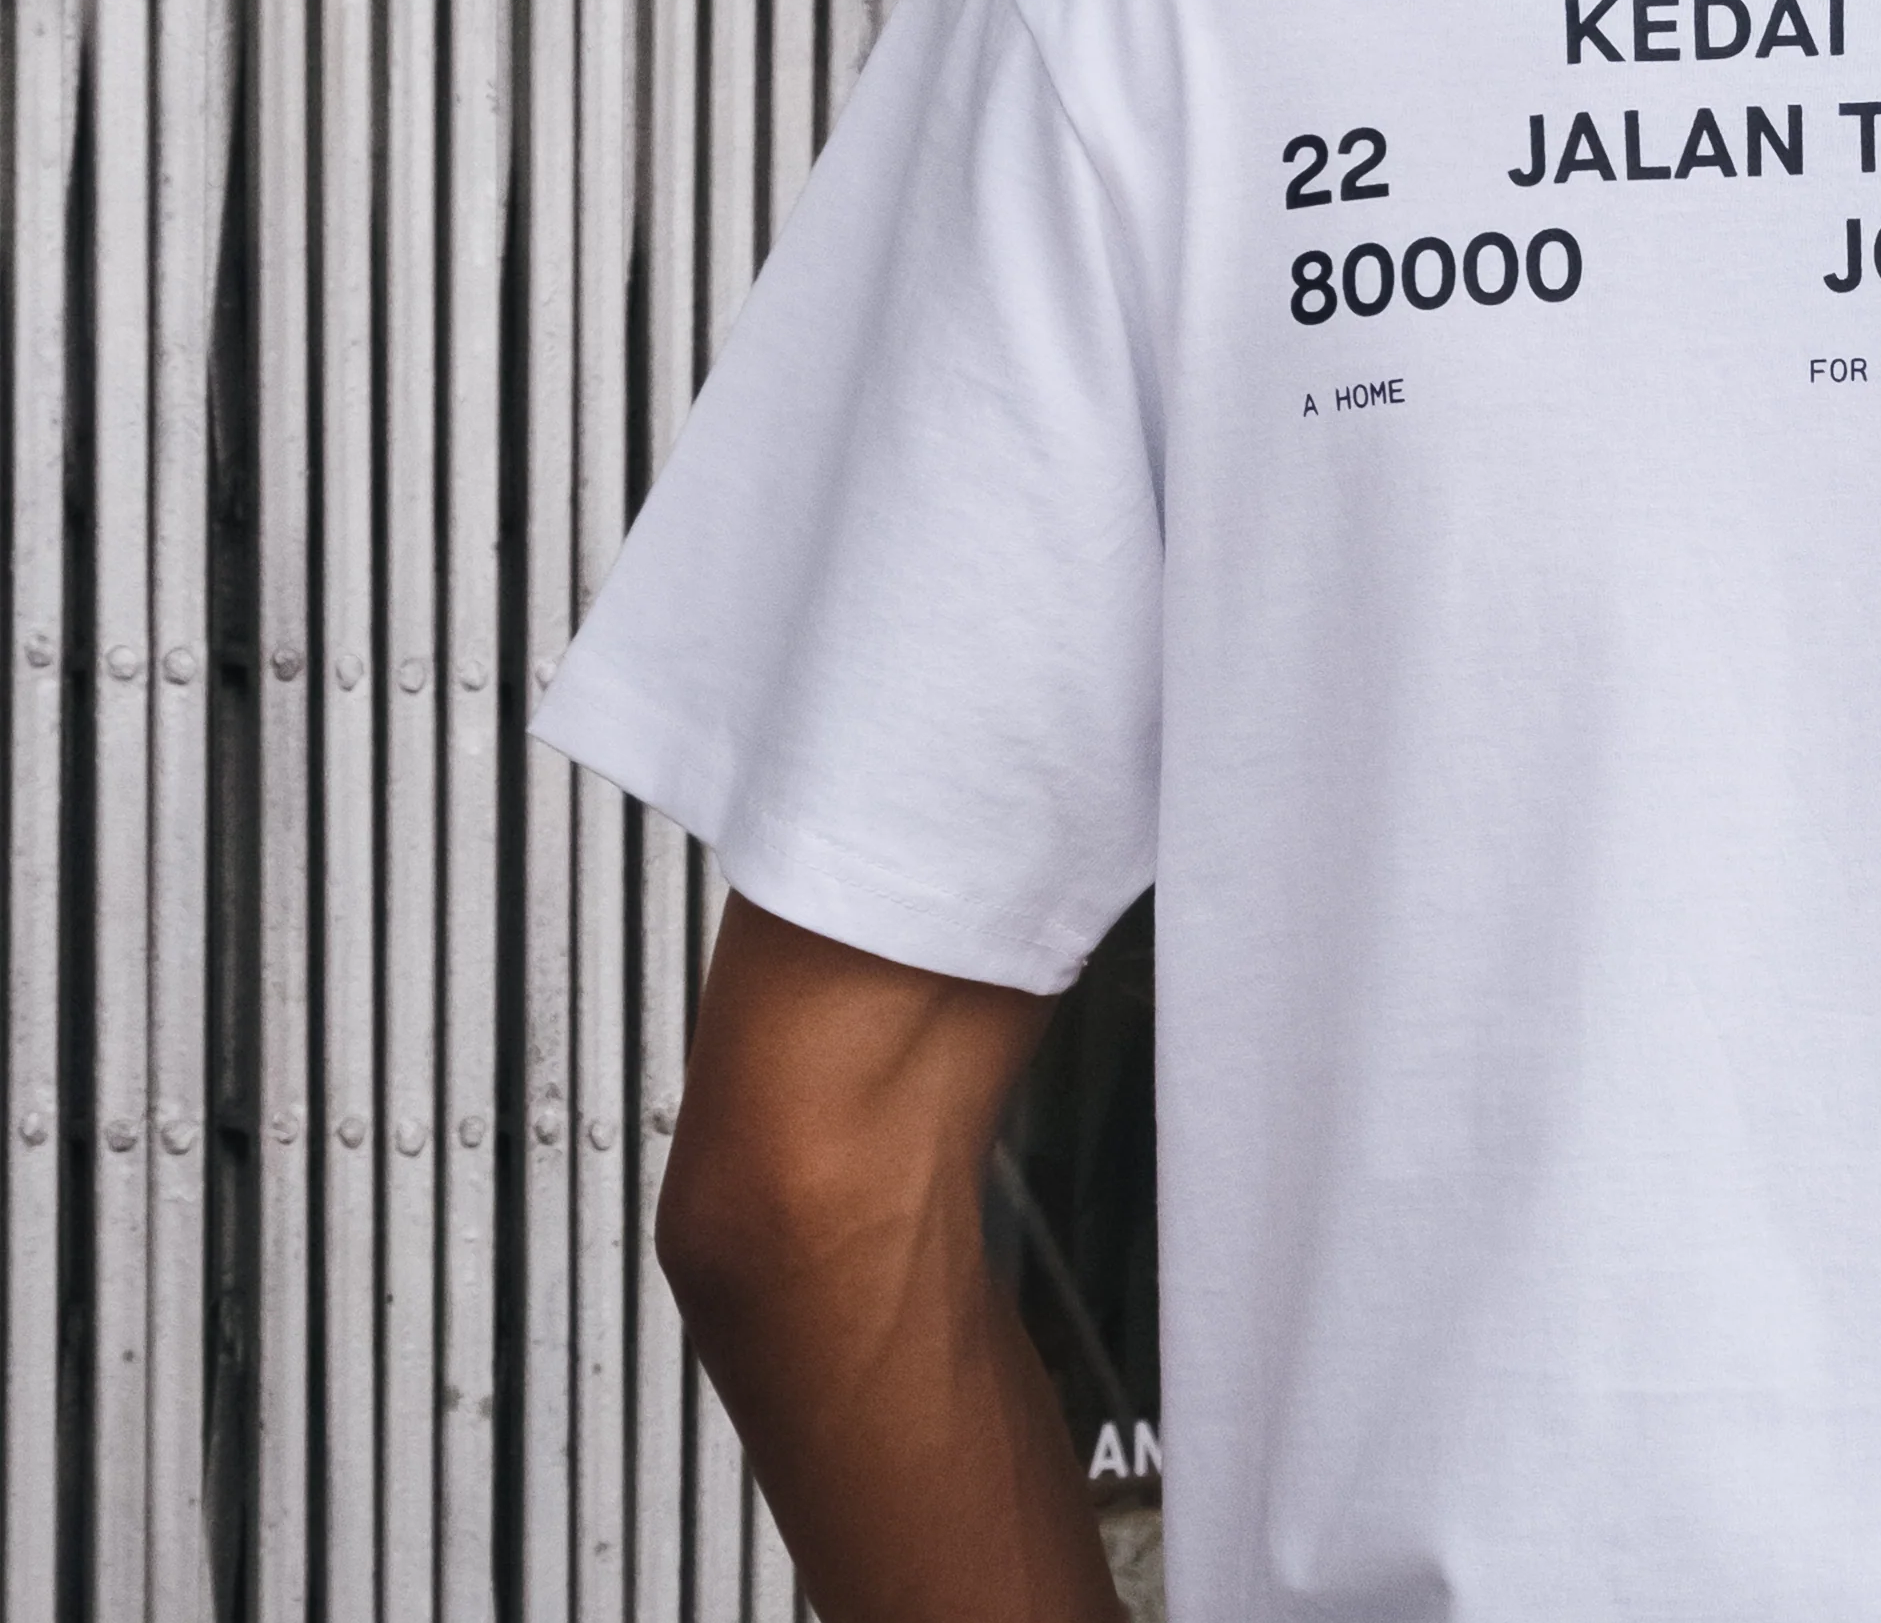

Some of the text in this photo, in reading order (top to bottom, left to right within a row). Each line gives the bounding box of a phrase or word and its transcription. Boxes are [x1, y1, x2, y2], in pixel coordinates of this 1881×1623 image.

[1281, 126, 1390, 211] 22
[1507, 103, 1804, 188] JALAN
[1290, 227, 1583, 326] 80000
[1302, 393, 1319, 418] A
[1335, 378, 1406, 412] HOME
[1809, 357, 1868, 384] FOR
